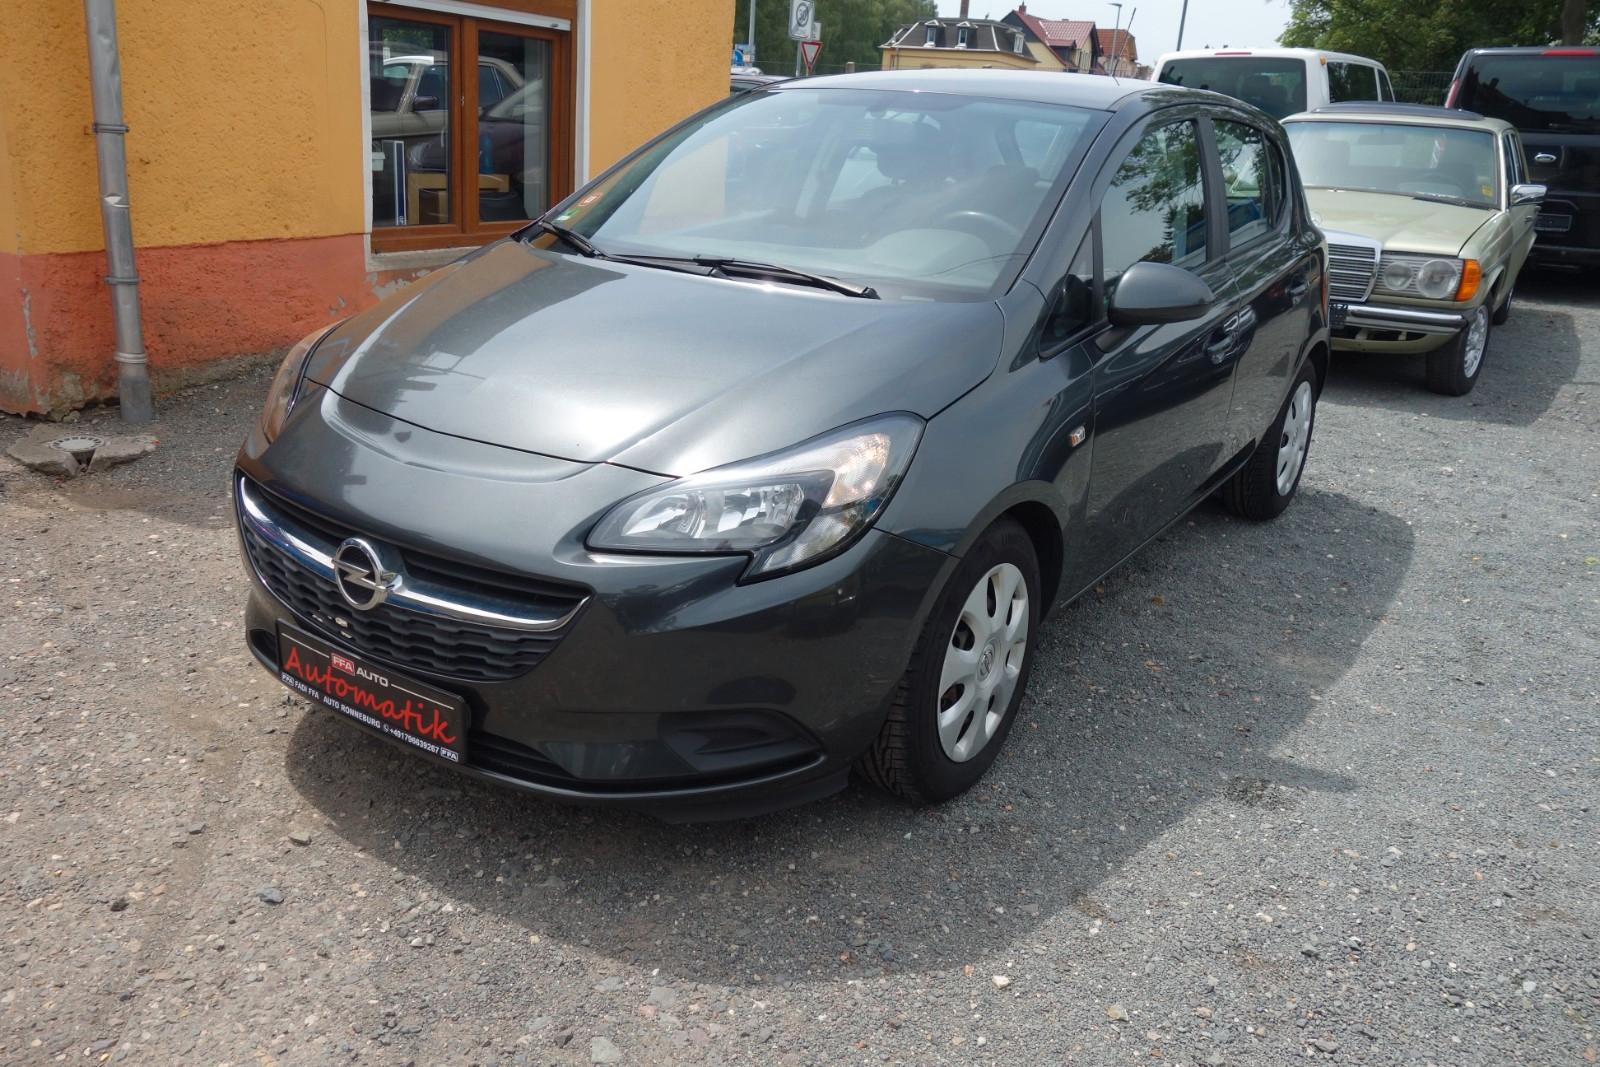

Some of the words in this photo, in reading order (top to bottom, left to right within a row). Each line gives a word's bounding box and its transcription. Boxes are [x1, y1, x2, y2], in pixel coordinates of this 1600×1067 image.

[284, 646, 457, 744] Automatik
[332, 655, 353, 673] FFA
[356, 667, 389, 688] AUTO
[294, 680, 308, 693] FADI
[308, 688, 320, 700] FFA
[323, 696, 340, 709] AUTO
[340, 704, 381, 729] RONNEBURG
